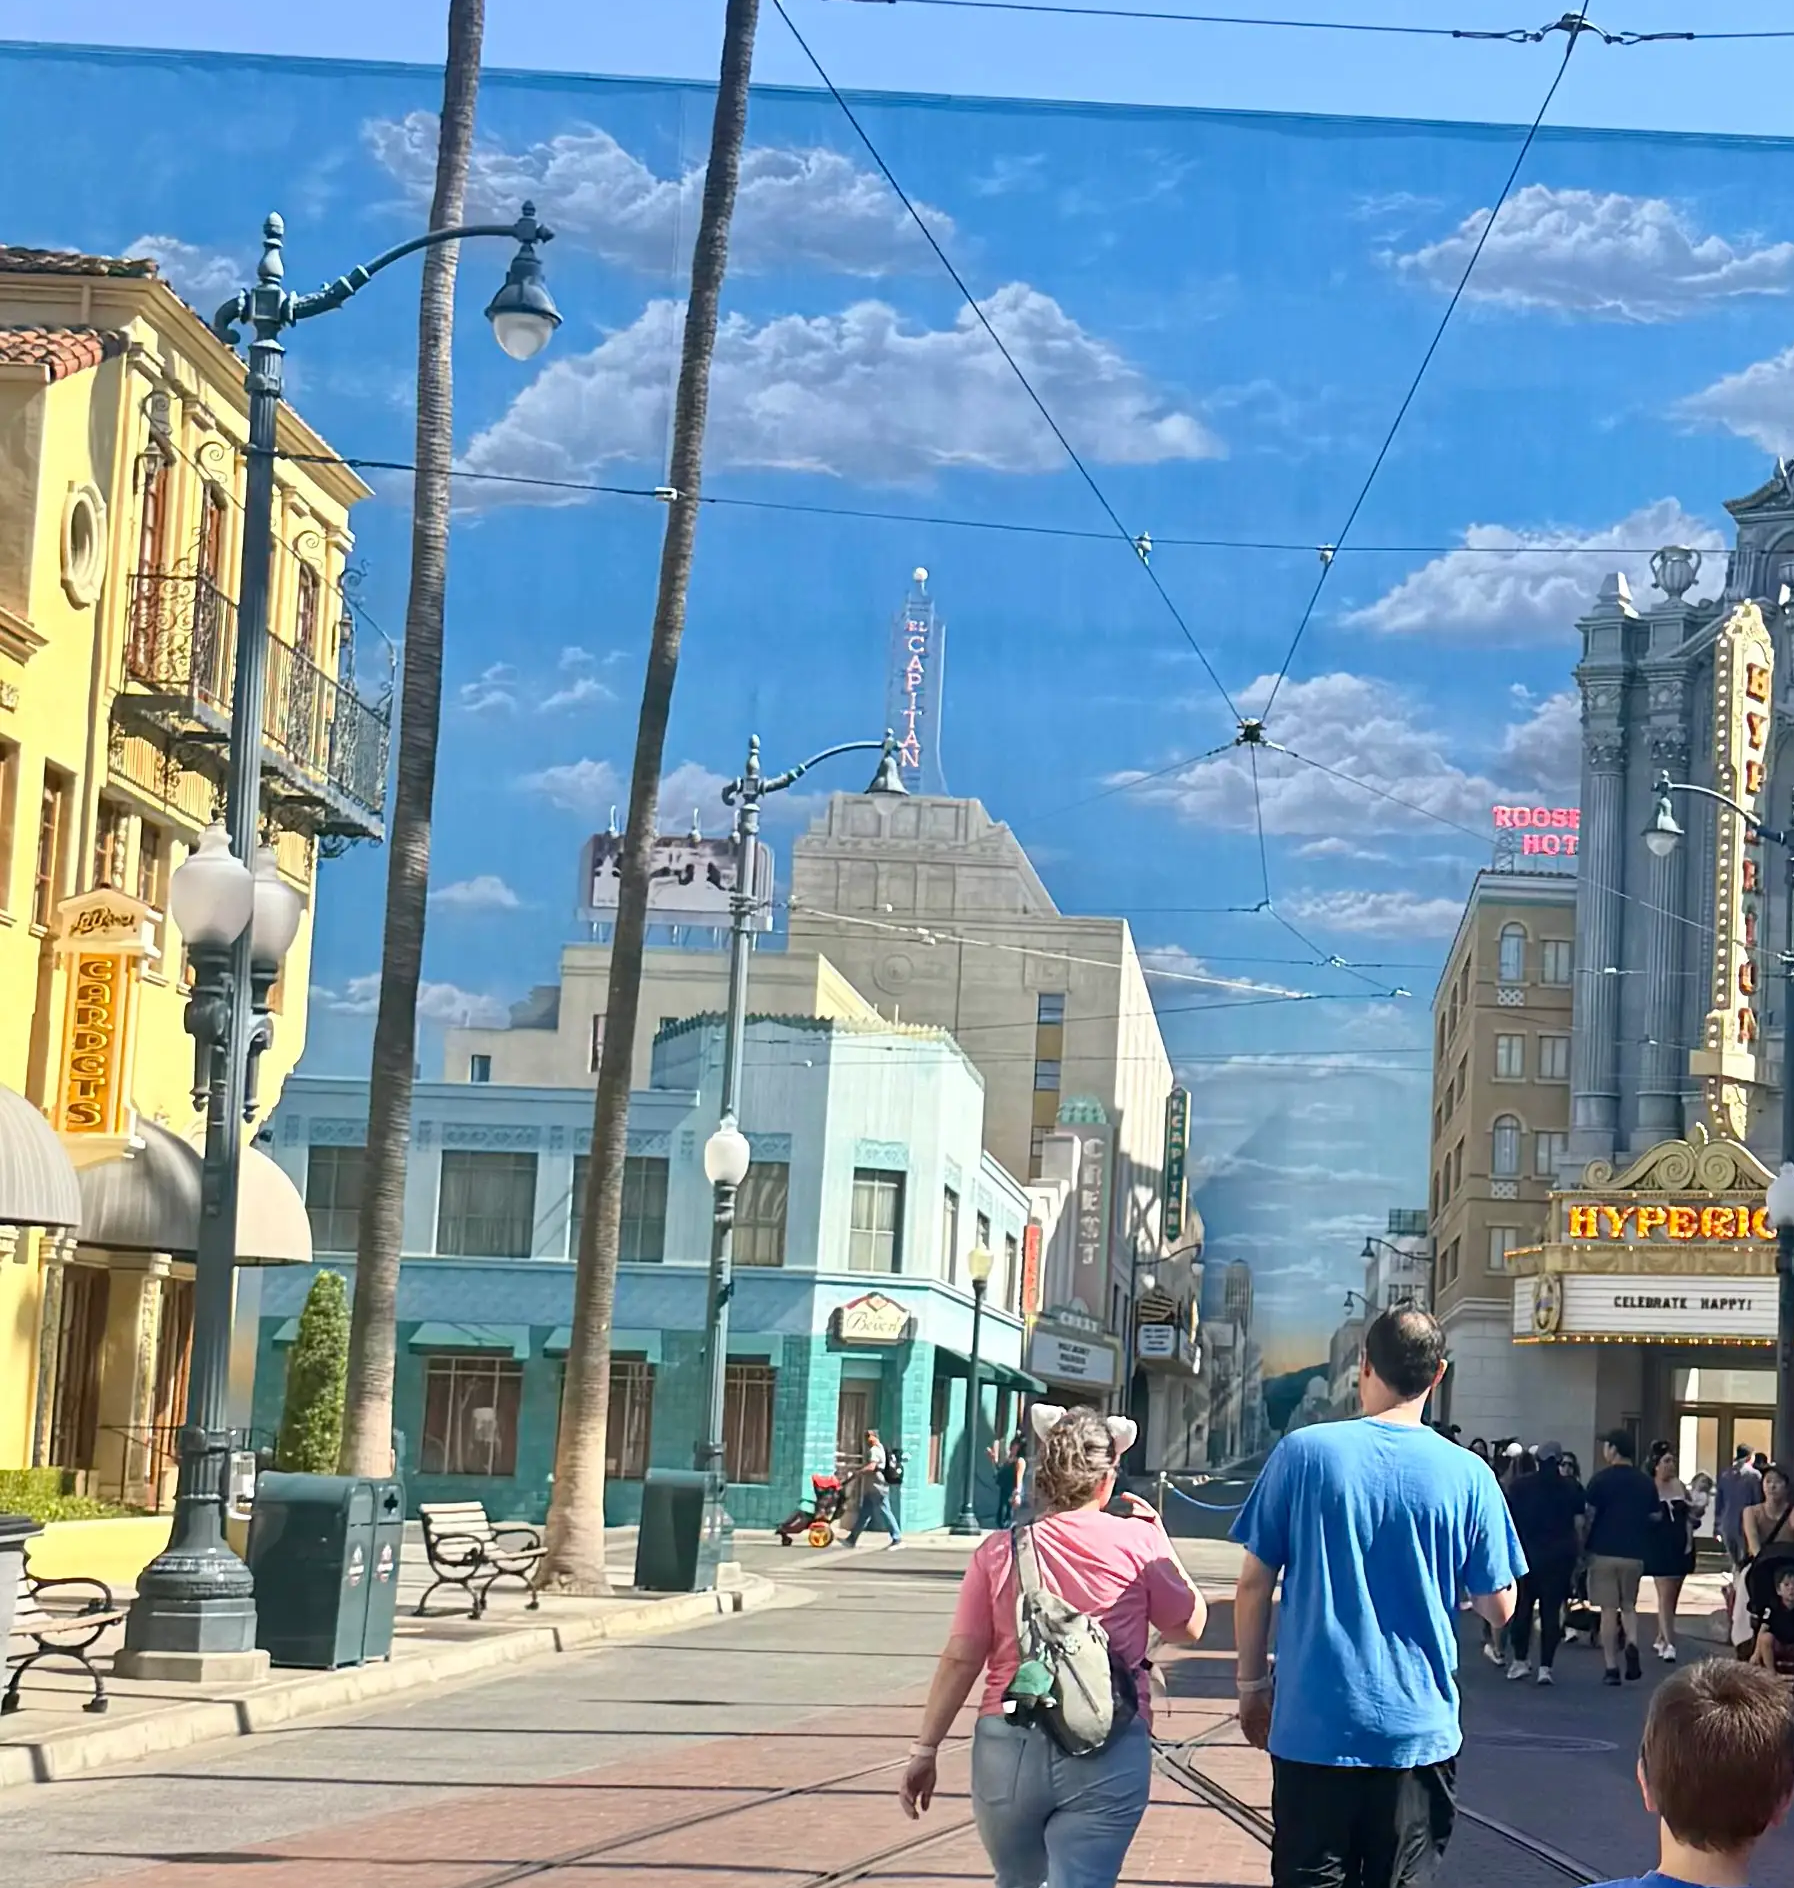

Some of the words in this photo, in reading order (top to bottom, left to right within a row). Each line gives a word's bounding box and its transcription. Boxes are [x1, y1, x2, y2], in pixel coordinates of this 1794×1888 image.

[901, 635, 926, 768] CAPITAN
[66, 960, 113, 1127] CARPETS
[1078, 1138, 1105, 1265] CREST
[1614, 1295, 1687, 1310] CELEBRATE
[1700, 1297, 1752, 1311] HAPPY!
